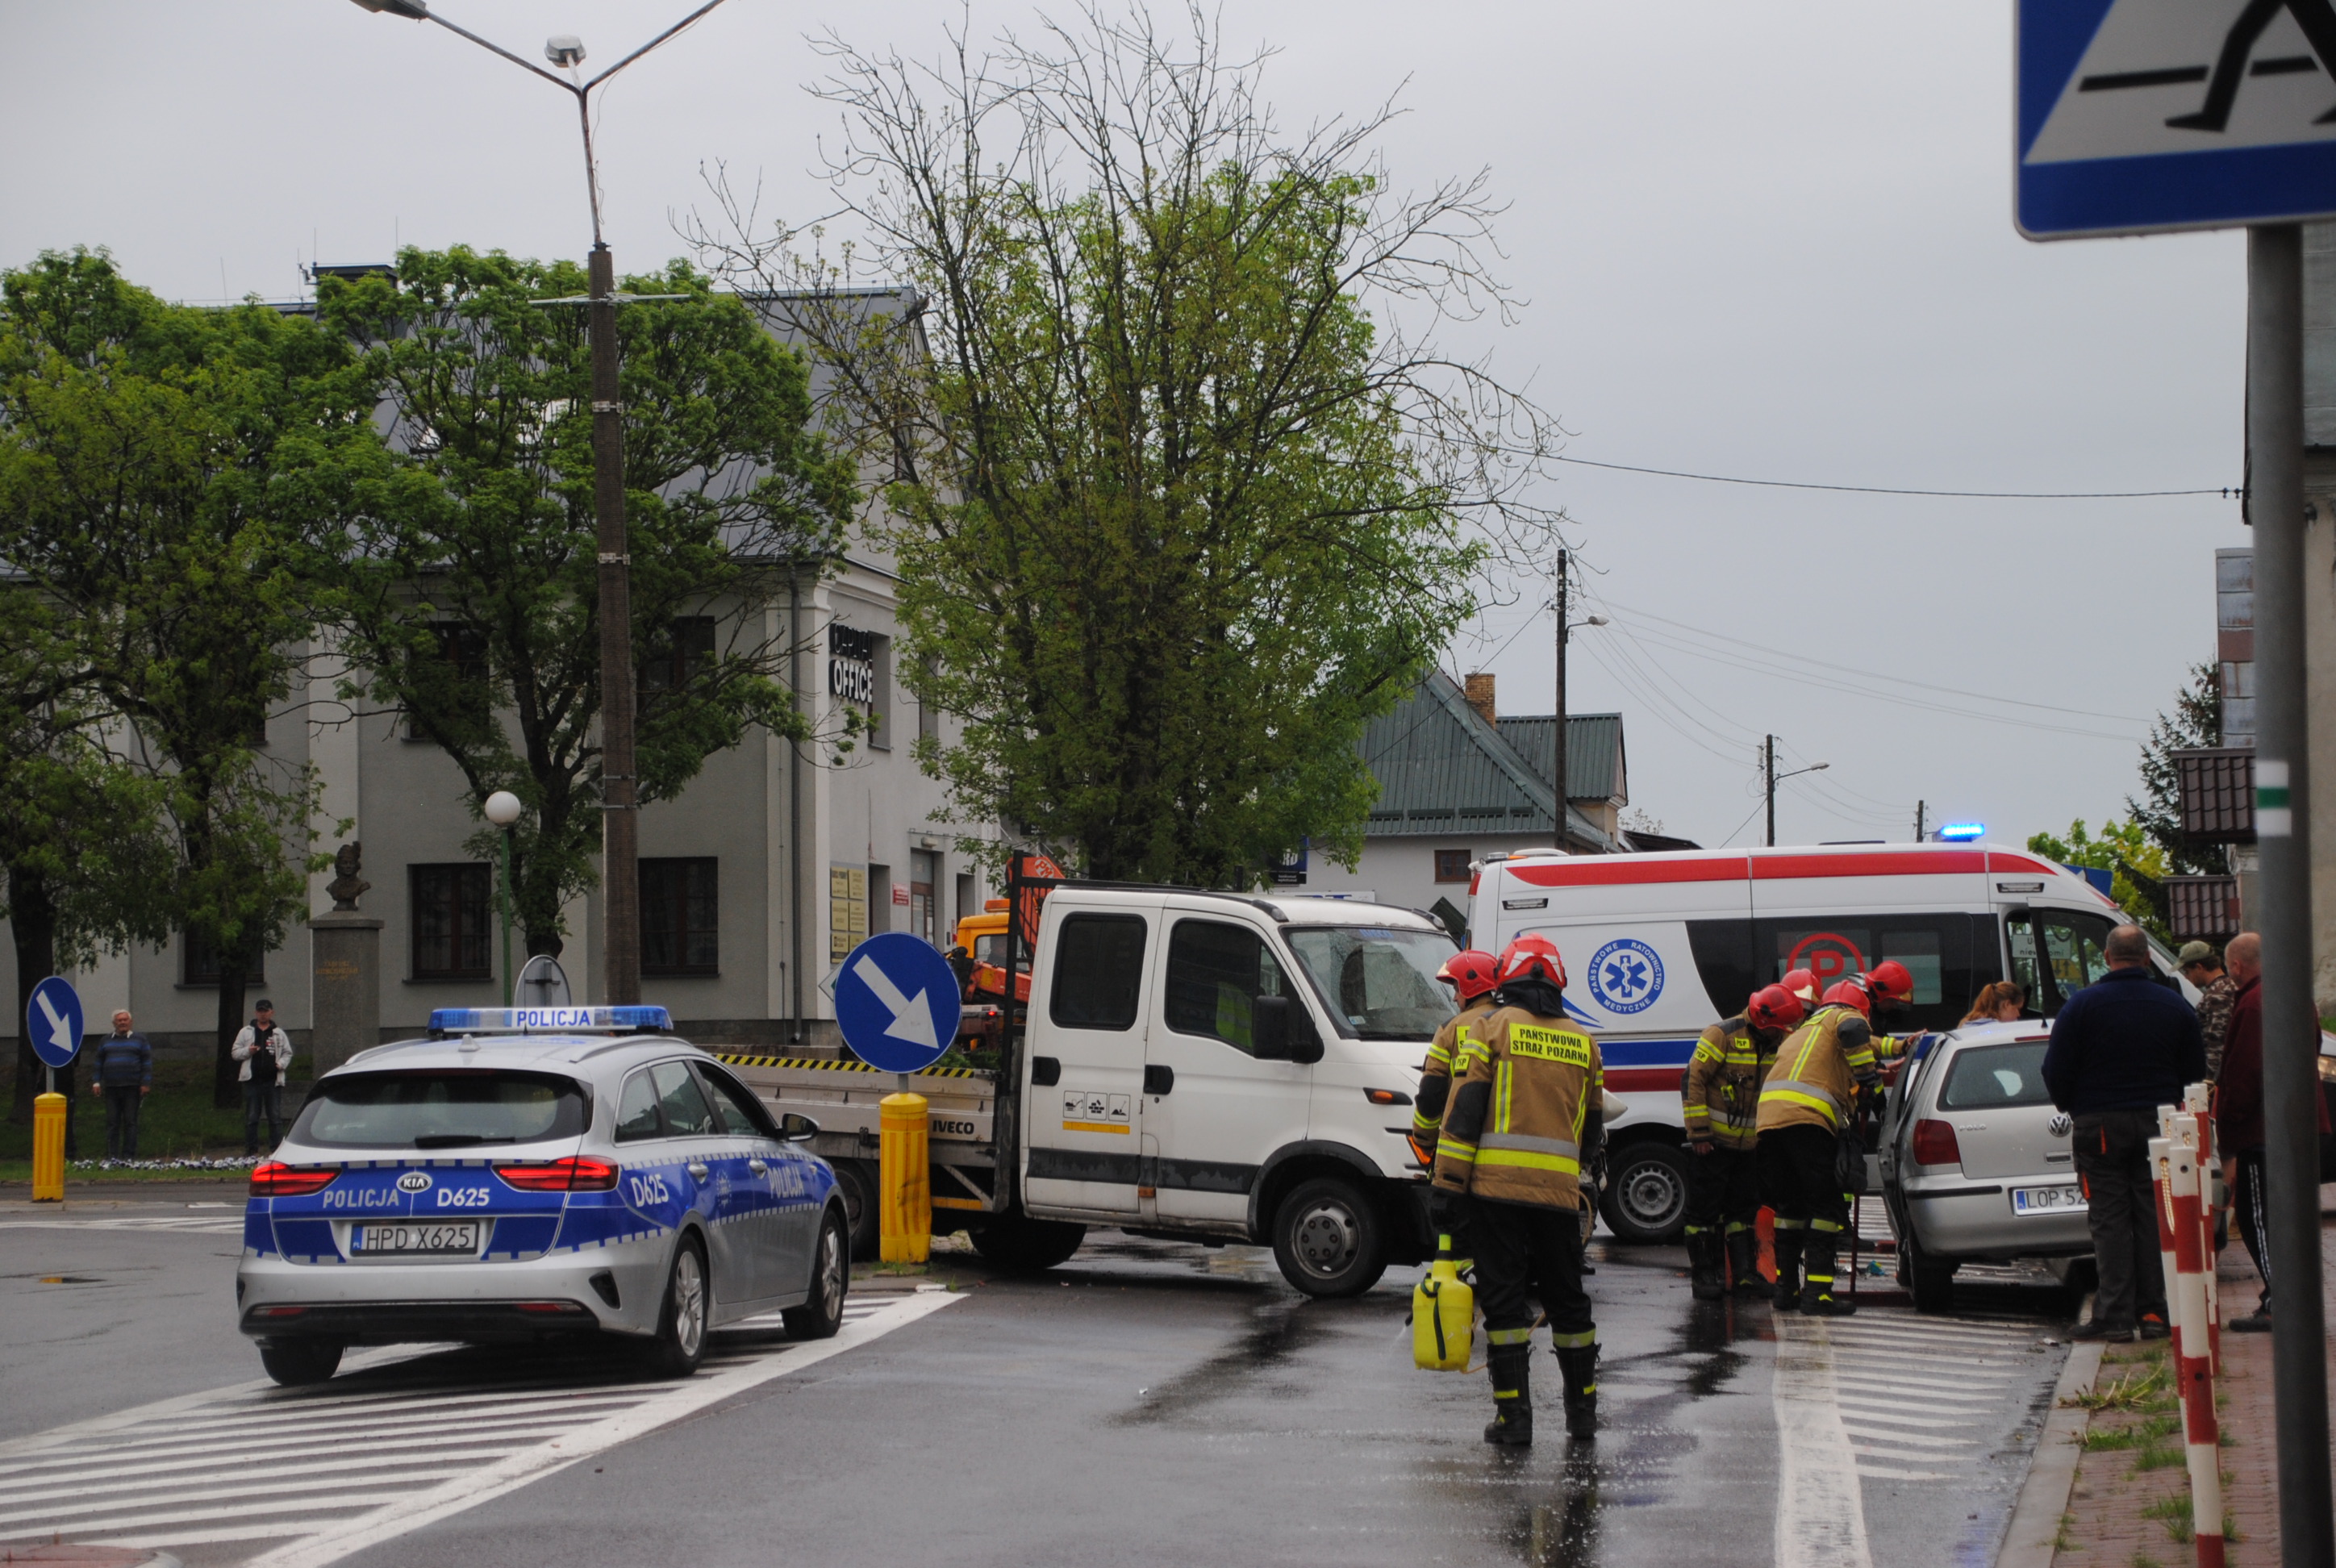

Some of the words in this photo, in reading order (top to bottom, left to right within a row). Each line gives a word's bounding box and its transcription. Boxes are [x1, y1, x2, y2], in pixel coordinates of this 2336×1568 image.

[833, 660, 873, 703] OFFICE
[2027, 937, 2056, 946] Uga
[2020, 948, 2063, 956] nieomi
[1589, 942, 1619, 993] PAŃSTWOWE
[1630, 941, 1662, 990] RATOWNICTWO
[1604, 998, 1651, 1012] MEDYCZNE
[517, 1010, 590, 1027] POLICJA
[1519, 1028, 1582, 1049] PAŃSTWOWA
[1512, 1040, 1543, 1055] STRAŻ
[1547, 1045, 1588, 1064] POŻARNA
[932, 1120, 974, 1135] IVECO
[1959, 1123, 1987, 1132] POLO
[403, 1178, 425, 1188] KIA
[630, 1174, 669, 1207] D625
[766, 1166, 805, 1199] POLICJA
[323, 1188, 399, 1208] POLICJA
[437, 1187, 490, 1207] D625
[2025, 1190, 2059, 1208] LOP
[2065, 1189, 2087, 1206] 52
[366, 1228, 407, 1249] HPD
[416, 1226, 469, 1249] X625
